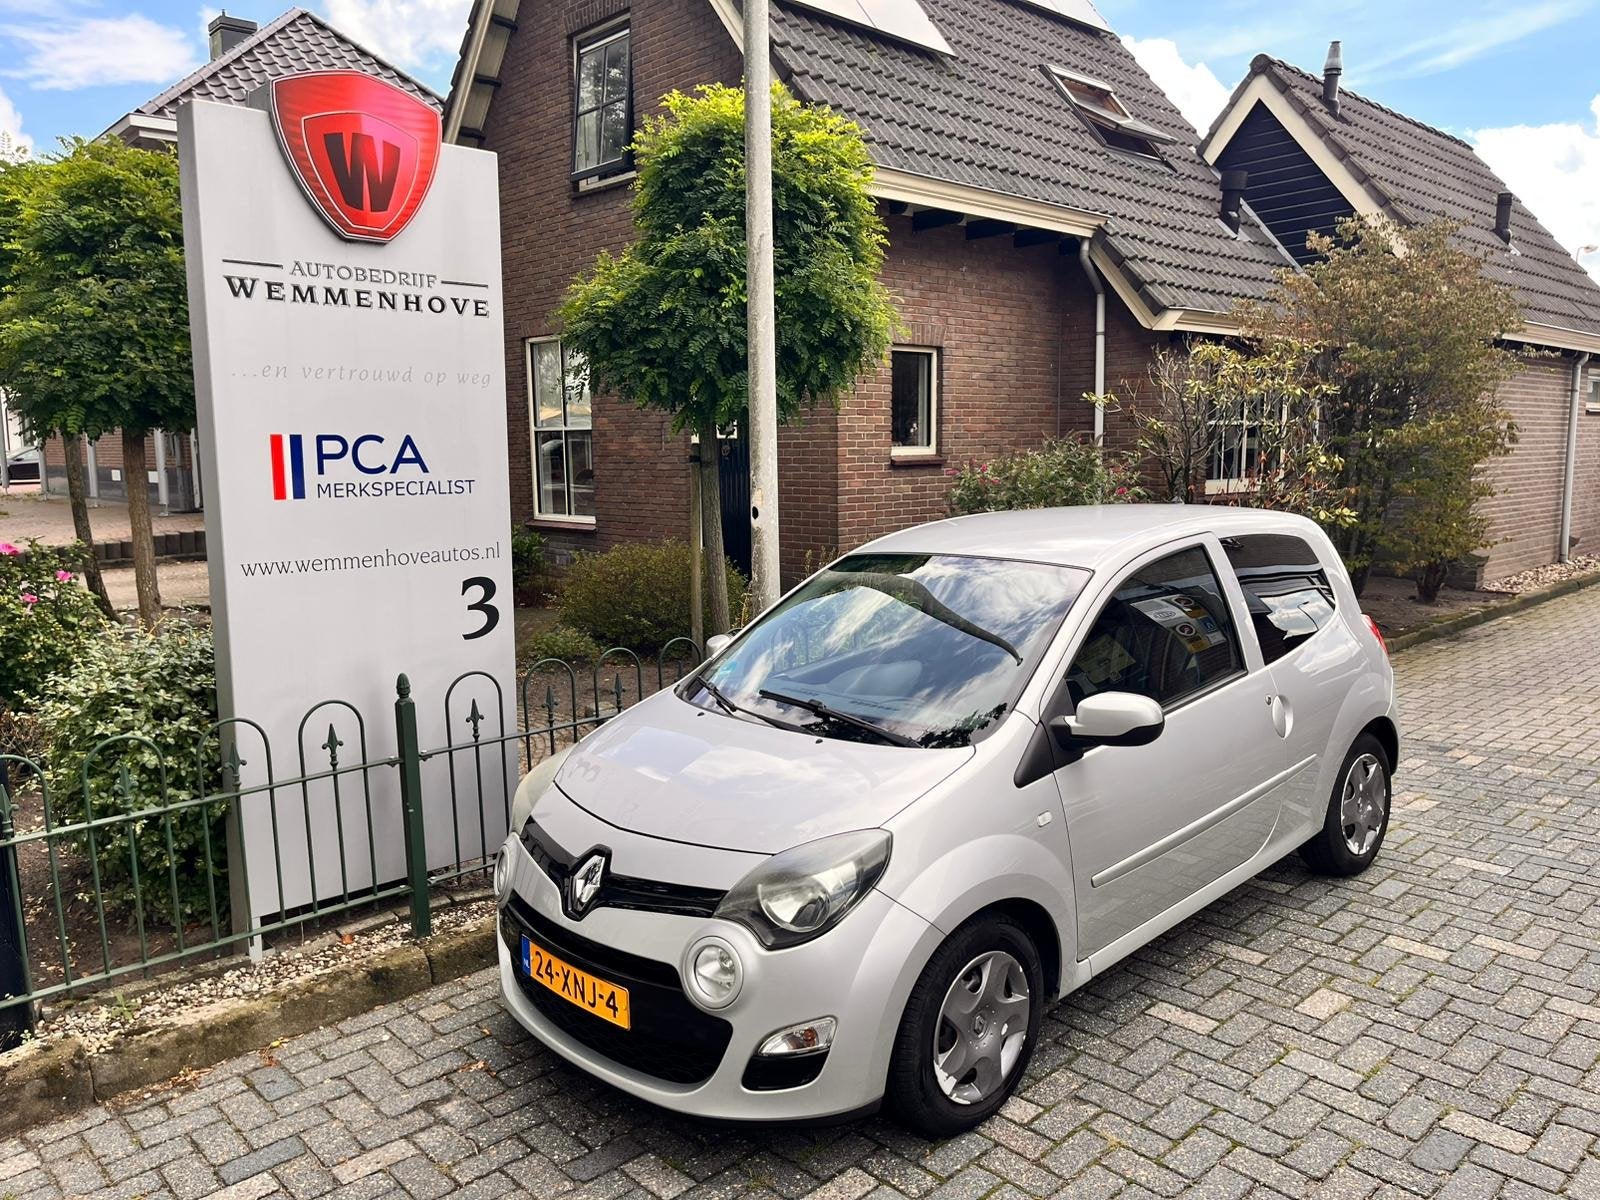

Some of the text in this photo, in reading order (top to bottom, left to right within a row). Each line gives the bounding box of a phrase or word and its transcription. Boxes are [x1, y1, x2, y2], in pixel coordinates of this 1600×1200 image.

[323, 132, 401, 213] W
[288, 260, 438, 289] AUTOBEDRIJF
[222, 275, 490, 317] WEMMENHOVE
[302, 366, 414, 383] vertrouwd
[423, 371, 447, 386] op
[456, 373, 491, 388] weg
[315, 434, 430, 476] PCA
[317, 479, 476, 499] MERKSPECIALIST
[240, 541, 501, 577] www.wemmenhoveautos.nl
[460, 575, 500, 641] 3
[535, 951, 618, 1018] 24-XNJ-4
